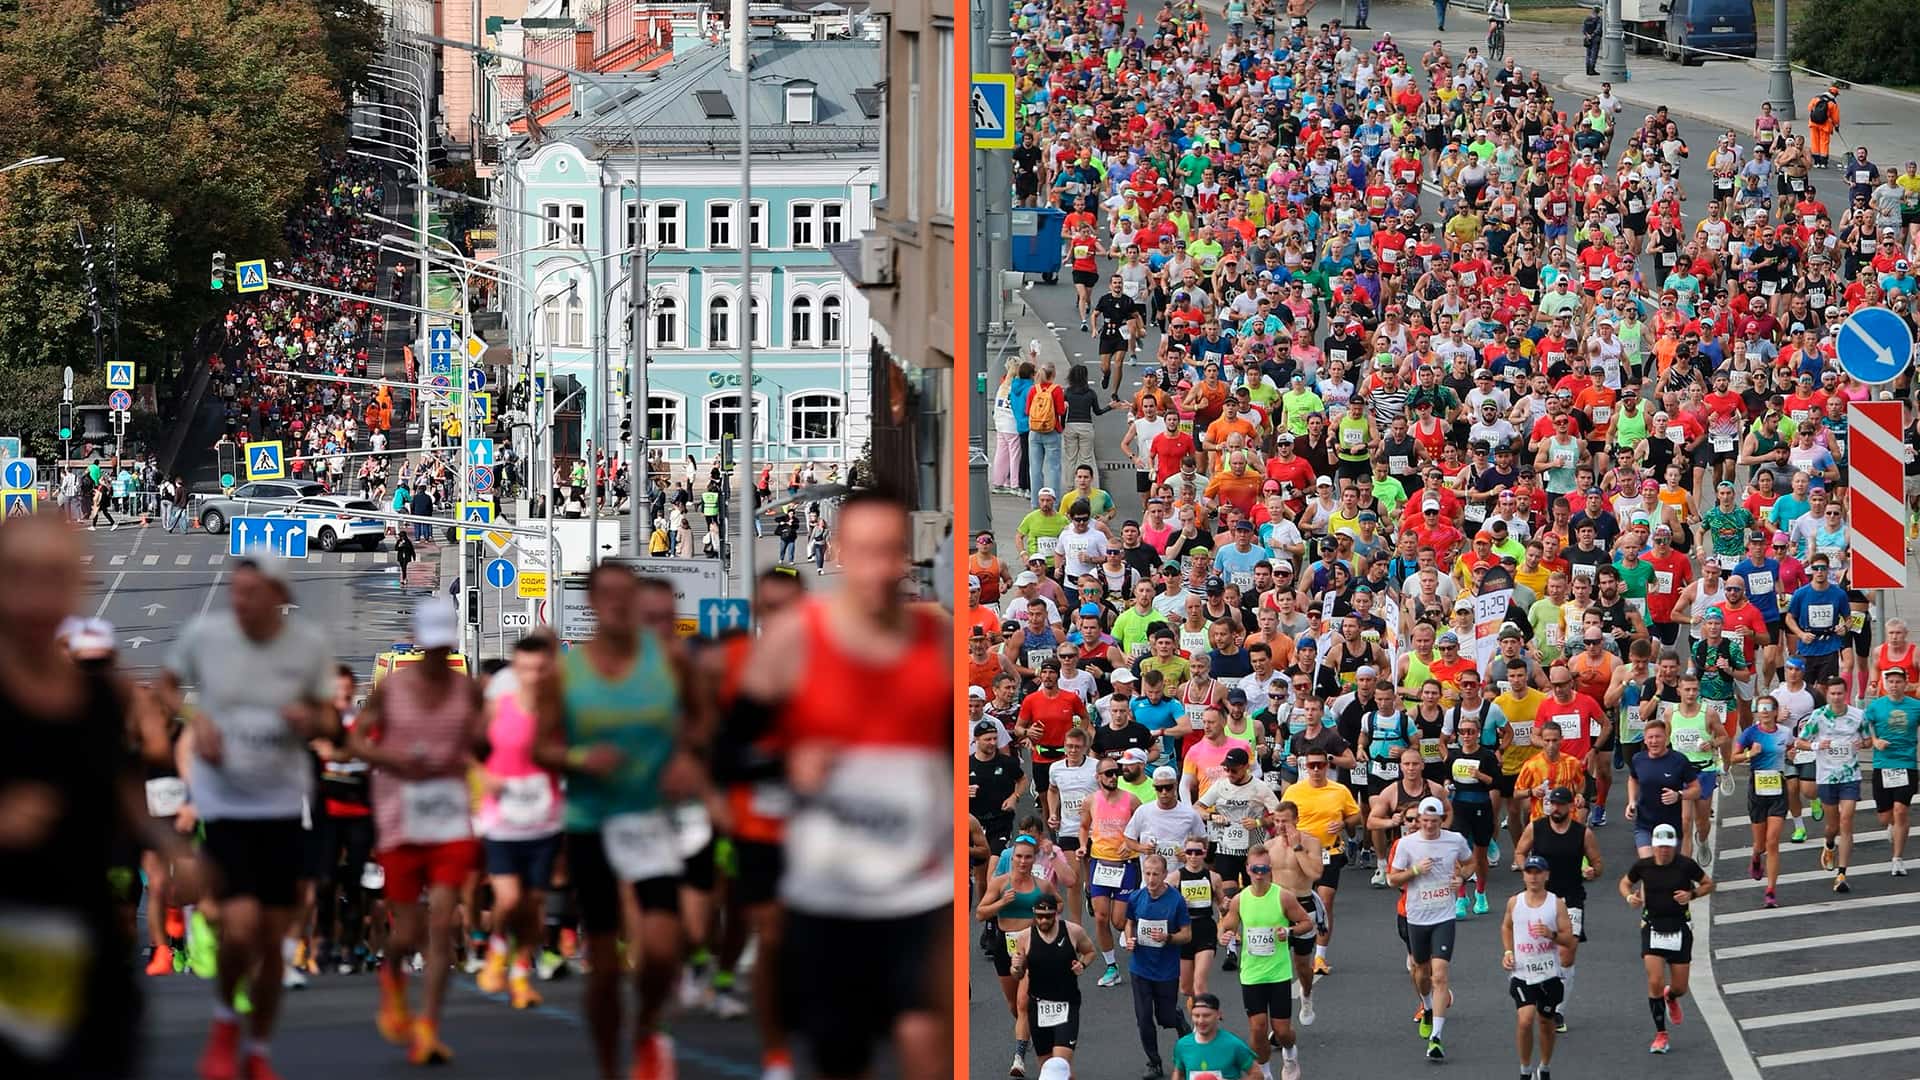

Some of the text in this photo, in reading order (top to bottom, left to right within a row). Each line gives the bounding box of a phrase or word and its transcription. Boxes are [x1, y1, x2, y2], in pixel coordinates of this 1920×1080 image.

[726, 374, 762, 386] СБР
[1479, 595, 1506, 618] 3:29
[1185, 886, 1207, 896] 3947
[1422, 887, 1450, 900] 21483
[1247, 935, 1274, 945] 16766
[1526, 959, 1554, 972] 18419
